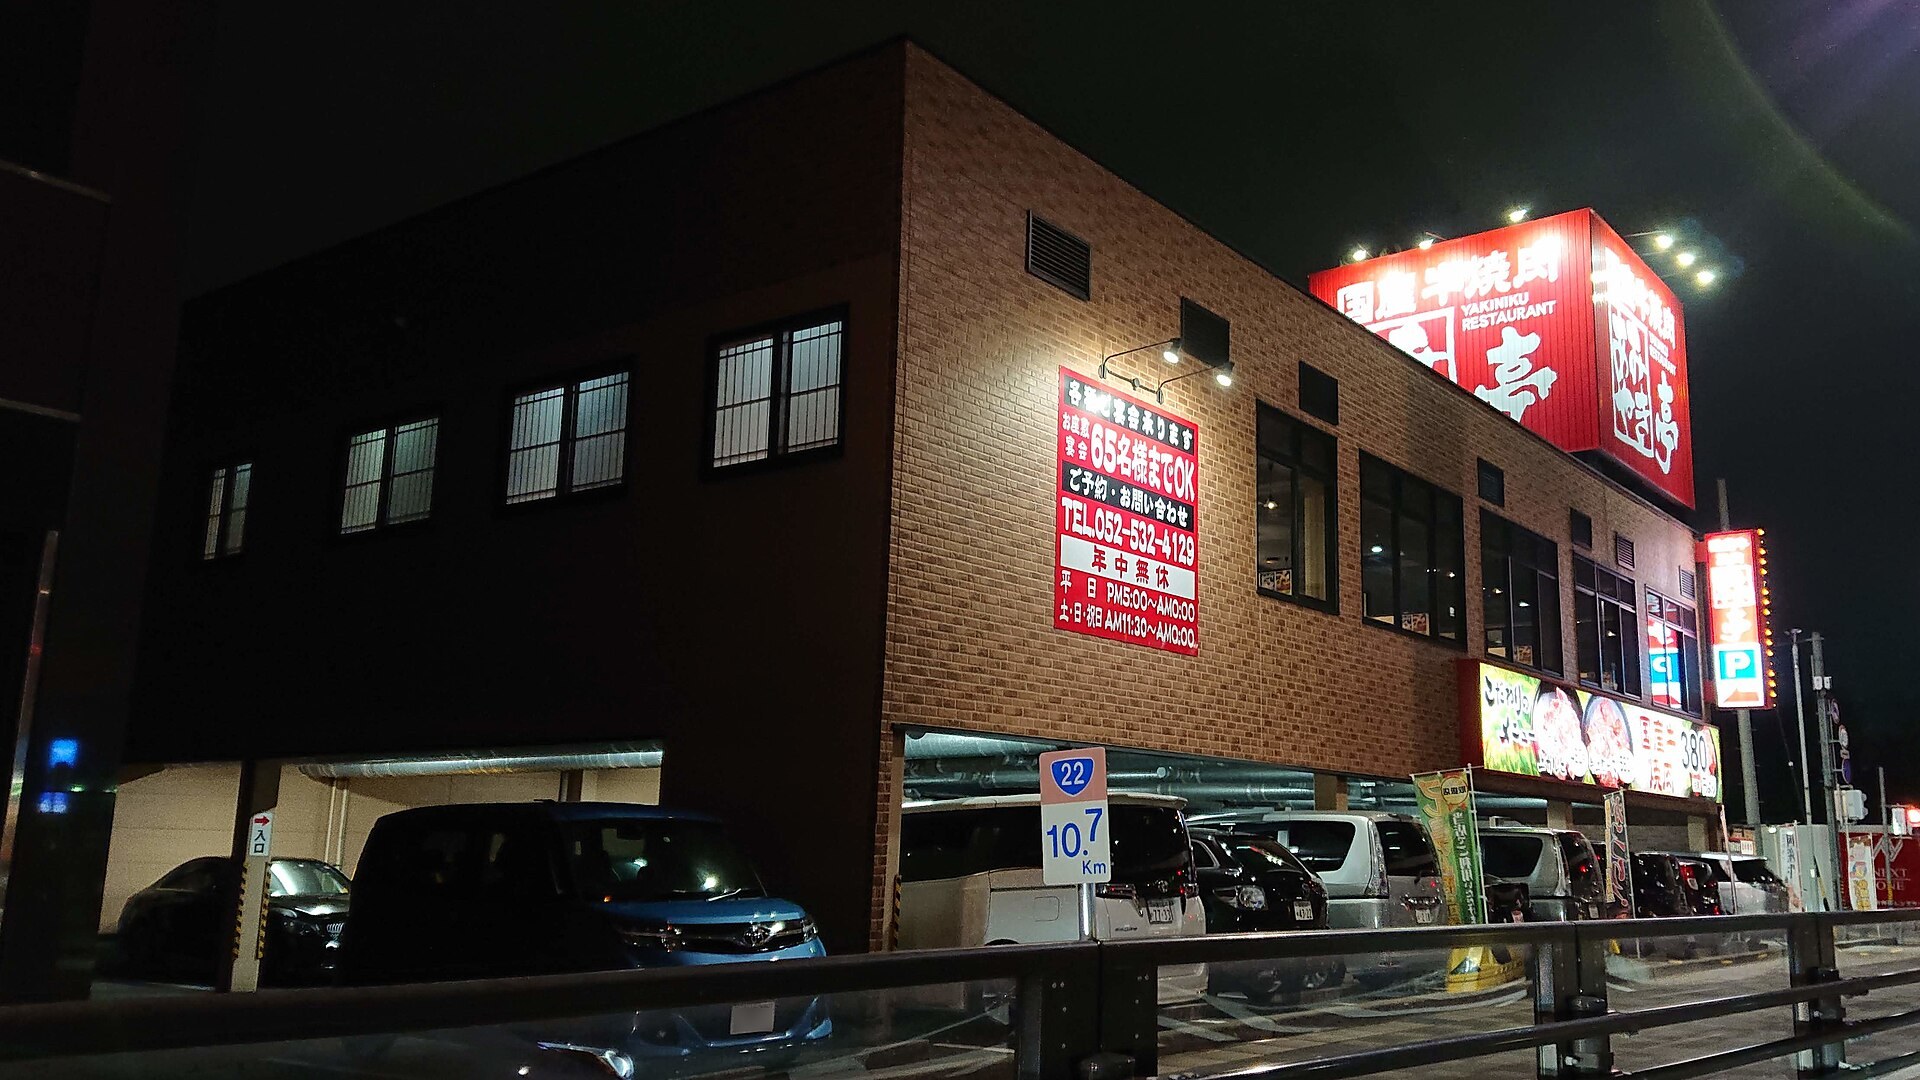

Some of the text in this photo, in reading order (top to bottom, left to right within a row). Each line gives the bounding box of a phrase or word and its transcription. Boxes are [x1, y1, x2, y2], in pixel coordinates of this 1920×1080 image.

[1461, 292, 1529, 317] YAKINIKU
[1462, 301, 1557, 332] RESTAURANT
[1065, 435, 1088, 461] 宴会
[1090, 423, 1195, 502] 65名様までOK
[1069, 467, 1188, 527] ご予約・お問い合わせ
[1091, 545, 1169, 589] 年中無休
[1724, 651, 1751, 678] P
[1681, 731, 1707, 773] 380
[1061, 762, 1085, 786] 22
[253, 829, 266, 854] 入口
[1082, 860, 1107, 875] Km
